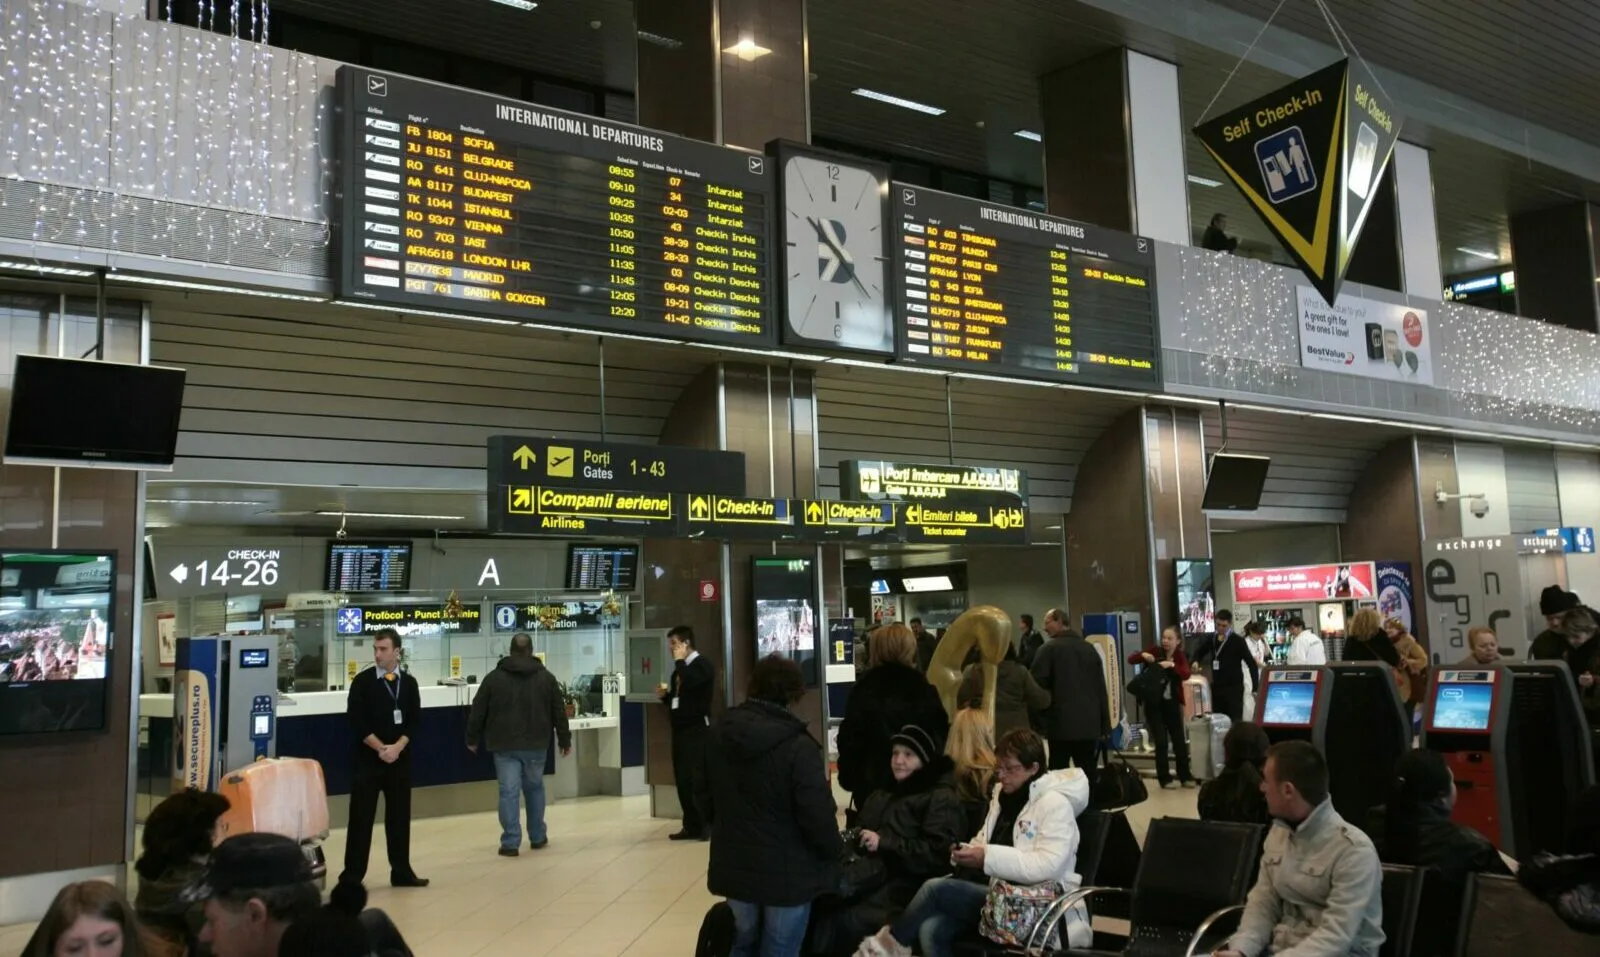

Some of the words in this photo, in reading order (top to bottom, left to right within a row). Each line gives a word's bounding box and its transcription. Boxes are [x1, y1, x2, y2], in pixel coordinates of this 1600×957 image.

[1223, 118, 1251, 142] Self
[1256, 89, 1323, 128] Check-In
[1354, 84, 1368, 108] Self
[1368, 97, 1393, 134] Check-In
[496, 104, 589, 137] INTERNATIONAL
[593, 124, 664, 152] DEPARTURES
[406, 125, 421, 136] FB
[428, 131, 453, 142] 1804
[464, 137, 495, 150] SOFIA
[609, 165, 634, 177] 08:55
[669, 176, 681, 186] 07
[408, 143, 421, 153] JU
[425, 146, 451, 158] 8151
[463, 153, 513, 170] BELGRADE
[609, 180, 635, 192] 09:10
[670, 191, 681, 201] 34
[826, 165, 840, 180] 12
[406, 159, 424, 170] RO
[434, 165, 454, 176] 641
[463, 171, 531, 189] CLUJ-NAPOCA
[609, 195, 634, 208] 09:25
[408, 177, 422, 187] AA
[426, 180, 453, 192] 8117
[463, 187, 512, 202] BUDAPEST
[610, 211, 635, 223] 10:35
[408, 194, 420, 204] TK
[427, 197, 453, 209] 1044
[464, 204, 510, 219] ISTANBUL
[610, 228, 634, 239] 10:50
[981, 207, 1038, 230] INTERNATIONAL
[1039, 220, 1084, 239] DEPARTURES
[406, 211, 424, 221] RO
[428, 214, 455, 226] 9347
[465, 220, 503, 234] VIENNA
[610, 243, 635, 255] 11:05
[405, 228, 423, 239] RO
[436, 232, 455, 243] 703
[464, 238, 486, 248] IASI
[610, 259, 635, 270] 11:35
[463, 254, 508, 267] LONDON
[511, 261, 530, 270] LHR
[611, 275, 635, 285] 11:45
[464, 271, 505, 284] MADRID
[611, 291, 635, 301] 12:05
[435, 283, 453, 294] 761
[506, 293, 545, 304] GOKCEN
[611, 306, 636, 317] 12:20
[1310, 313, 1326, 323] great
[1327, 314, 1338, 325] gift
[834, 325, 842, 338] 6
[1307, 345, 1345, 359] BestValue
[583, 450, 610, 468] Porți
[630, 460, 637, 475] 1
[650, 461, 665, 477] 43
[583, 467, 613, 480] Gates
[541, 490, 613, 511] Companii
[616, 494, 668, 511] aeriene
[717, 499, 774, 515] Check-in
[830, 504, 881, 519] Check-in
[923, 510, 952, 521] Emiteri
[955, 511, 977, 522] bilete
[541, 516, 585, 529] Airlines
[923, 527, 942, 536] Ticket
[943, 528, 967, 536] counter
[228, 550, 280, 560] CHECK-IN
[1436, 539, 1502, 551] exchange
[195, 560, 279, 586] 14-26
[477, 558, 501, 586] A
[415, 610, 440, 620] Punct
[440, 621, 460, 630] Point
